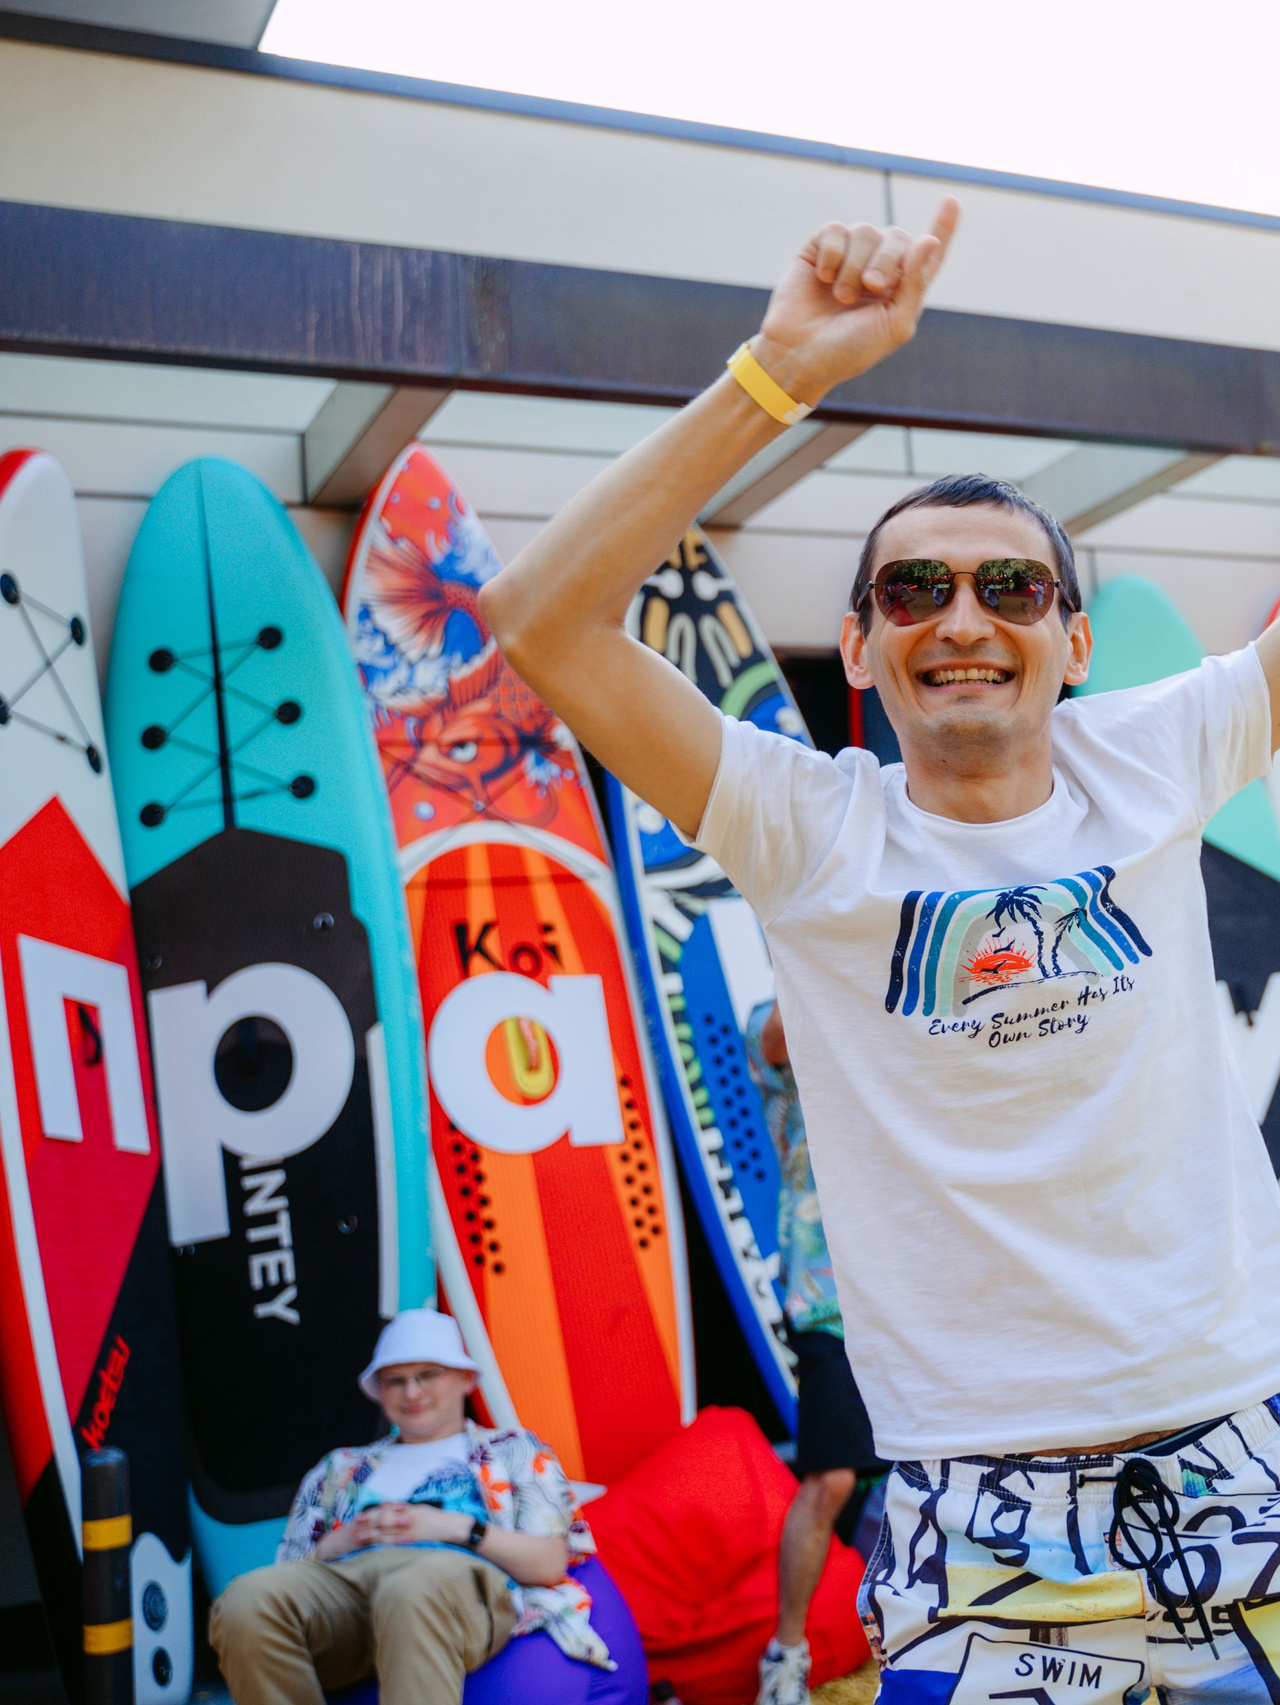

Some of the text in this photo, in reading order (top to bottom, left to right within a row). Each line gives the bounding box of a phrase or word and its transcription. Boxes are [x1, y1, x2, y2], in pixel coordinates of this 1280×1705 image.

[455, 921, 567, 978] Koi
[928, 974, 1136, 1039] Every Summer Has Its
[988, 1012, 1091, 1048] Own Story
[239, 1155, 300, 1325] INTEY
[1015, 1653, 1102, 1689] SWIM
